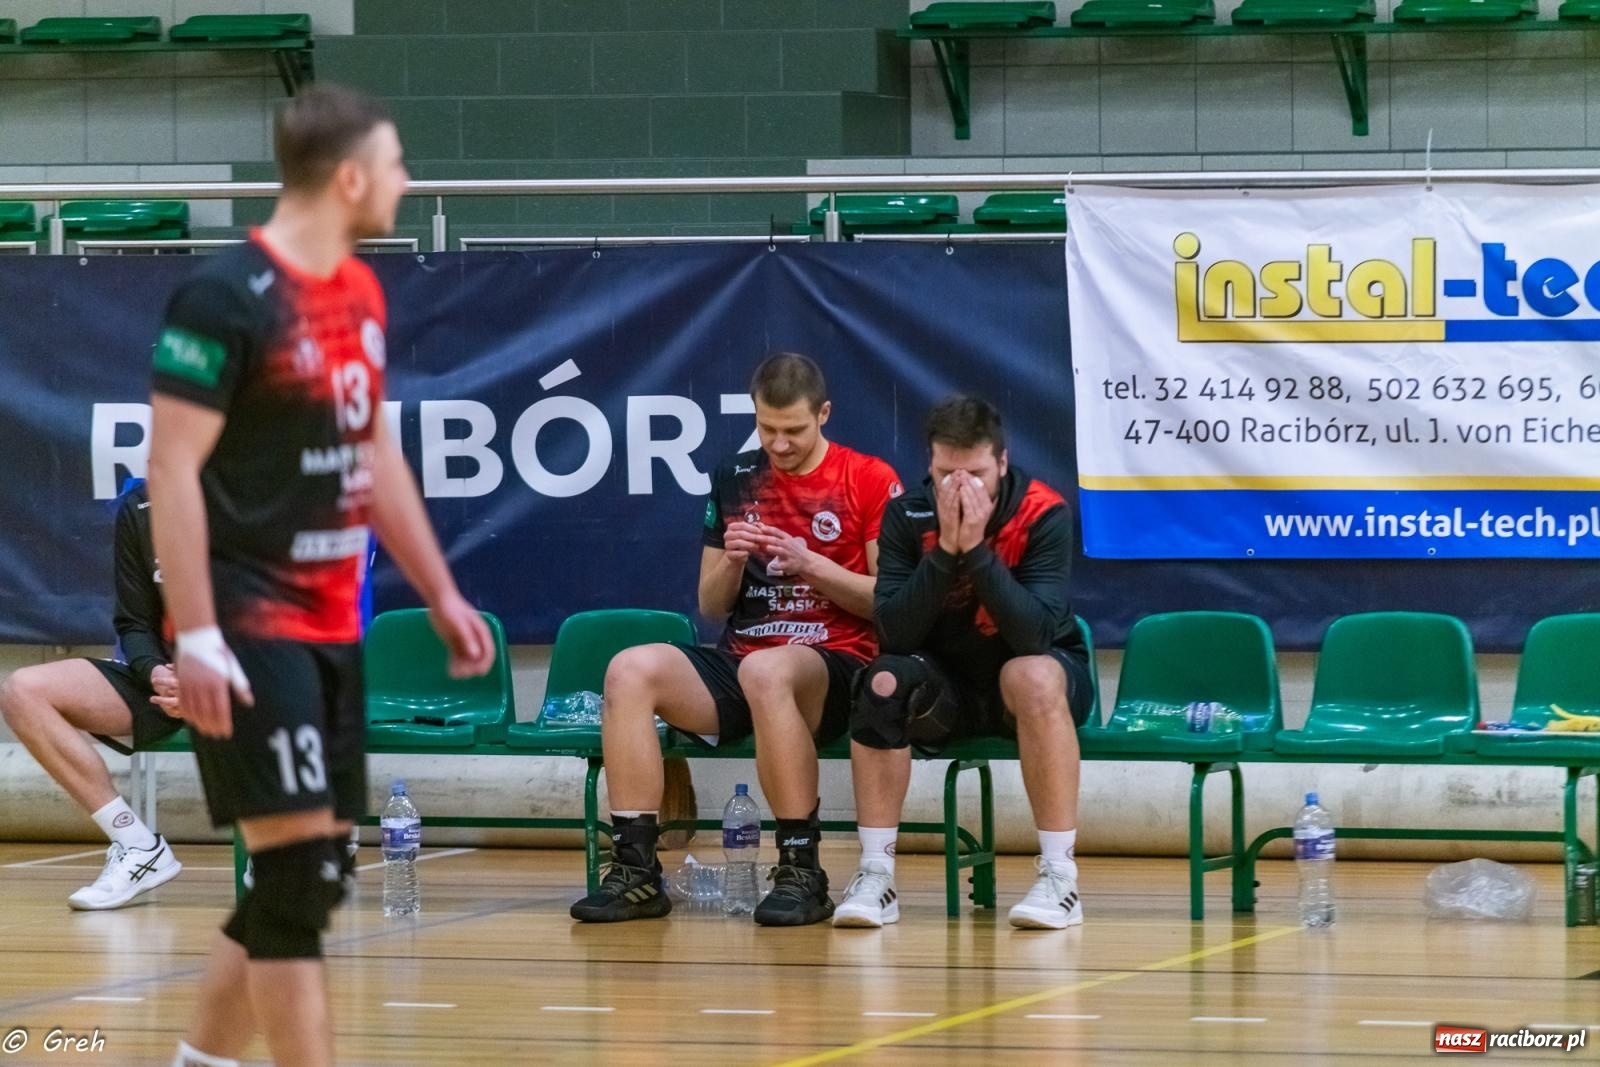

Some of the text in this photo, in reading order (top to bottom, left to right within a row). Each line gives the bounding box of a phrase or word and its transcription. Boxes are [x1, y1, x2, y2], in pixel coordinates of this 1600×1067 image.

[1173, 232, 1600, 342] instal-te
[330, 361, 373, 433] 13
[1102, 374, 1146, 400] tel.
[1155, 377, 1188, 401] 32
[1199, 377, 1256, 401] 414
[1265, 377, 1300, 402] 92
[1308, 376, 1351, 403] 88,
[1367, 377, 1421, 402] 502
[1432, 375, 1487, 401] 632
[1498, 374, 1561, 403] 695,
[1123, 419, 1231, 445] 47-400
[1241, 417, 1377, 446] Racibórz,
[1385, 417, 1420, 444] ul.
[1428, 418, 1448, 444] J.
[1457, 424, 1511, 444] von
[1264, 506, 1600, 546] www.instal-tech.pl
[268, 724, 327, 795] 13
